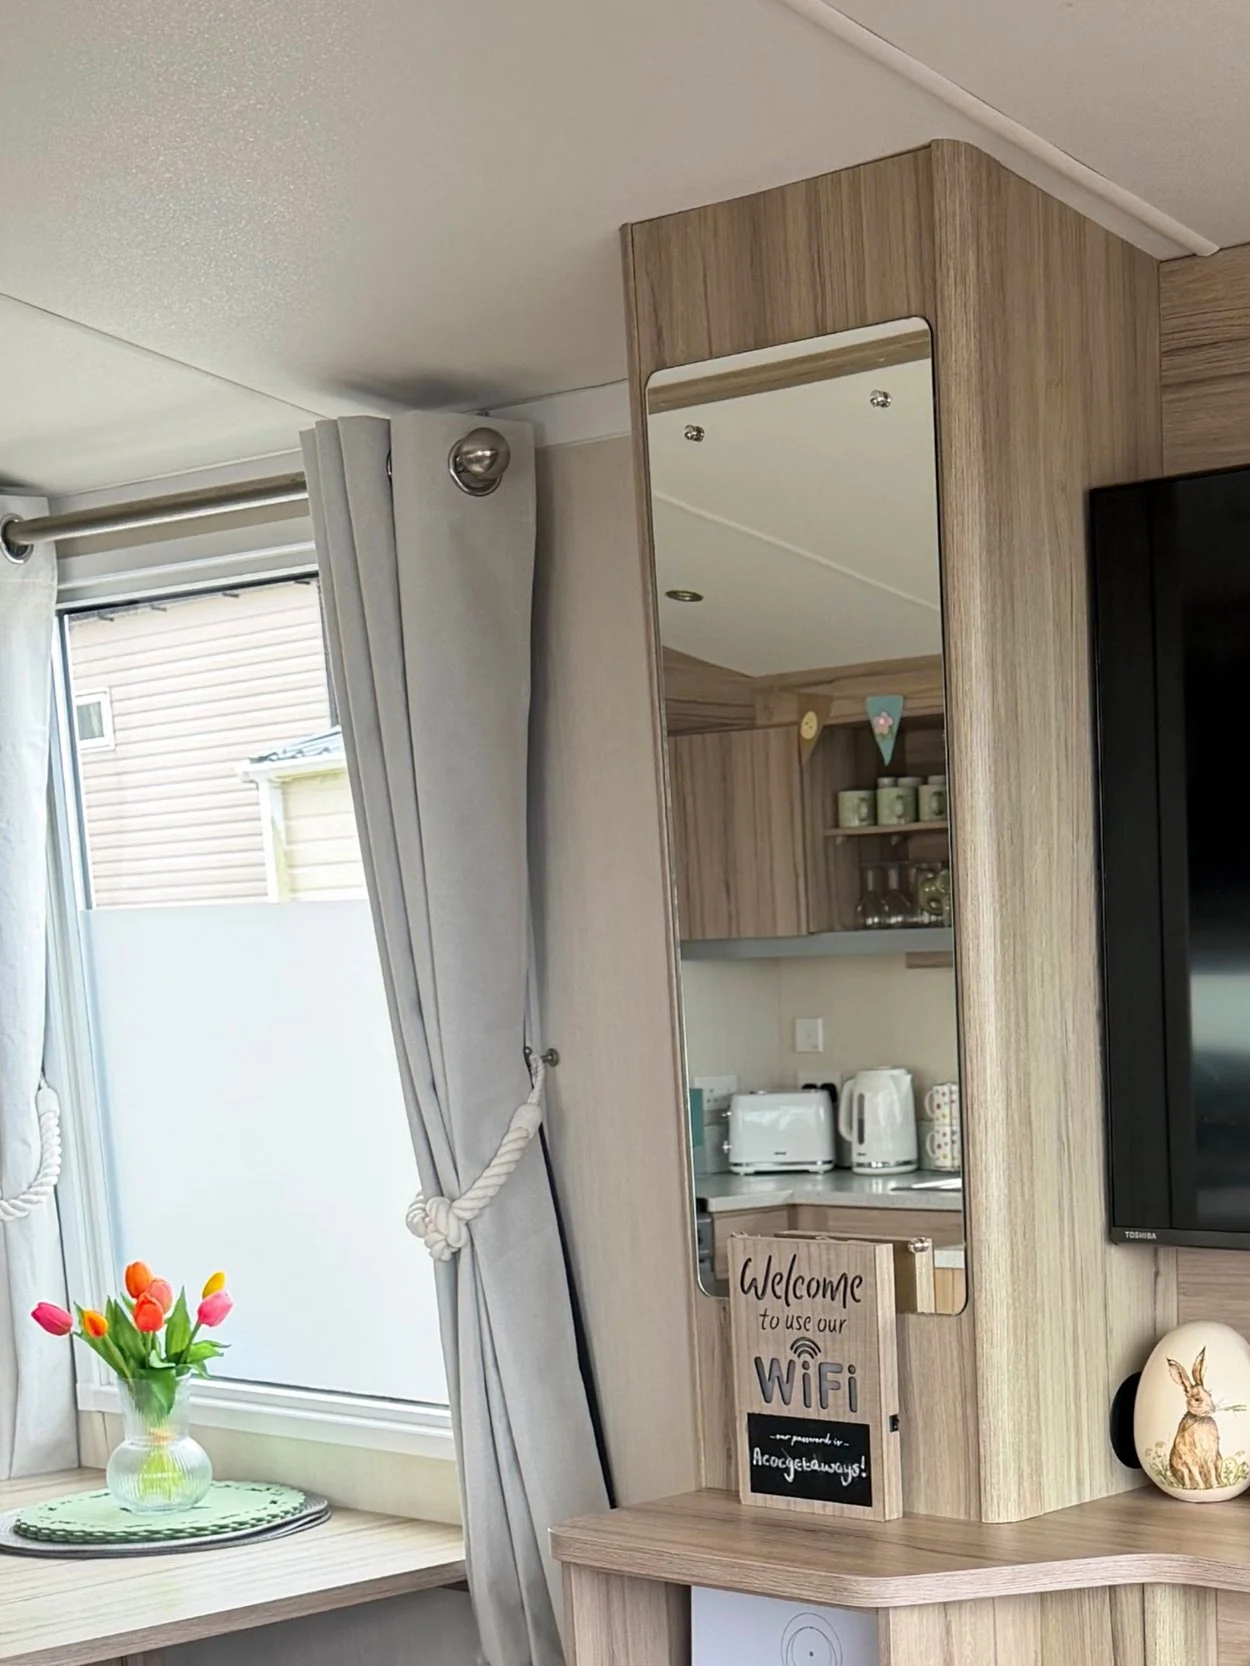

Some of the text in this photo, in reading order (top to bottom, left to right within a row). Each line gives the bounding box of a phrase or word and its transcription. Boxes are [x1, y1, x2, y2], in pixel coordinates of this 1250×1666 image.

[1124, 1231, 1157, 1240] TOSHIBA
[740, 1253, 864, 1310] Welcome
[759, 1308, 847, 1334] to use our
[754, 1356, 858, 1413] WiFi
